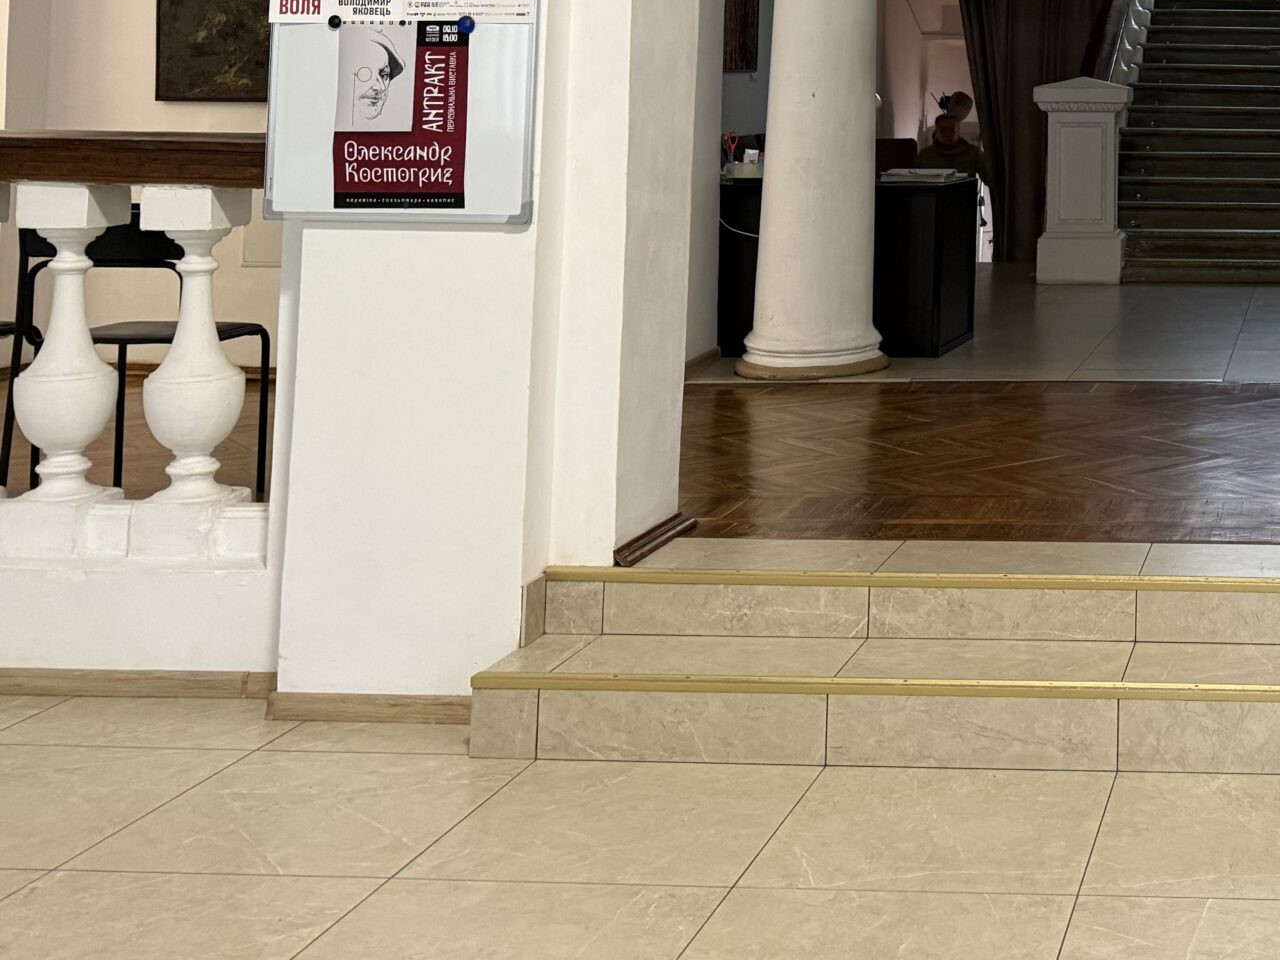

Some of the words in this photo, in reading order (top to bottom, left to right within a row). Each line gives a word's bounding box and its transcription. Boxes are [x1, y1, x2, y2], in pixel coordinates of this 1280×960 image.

[352, 7, 391, 16] ЯКОВЕЦЬ
[448, 51, 456, 86] ВИСТАВКА
[422, 51, 446, 132] АНТРАКТ
[447, 86, 456, 132] ПЕРСОНАЛЬНА
[344, 140, 452, 166] Олександр
[345, 162, 453, 188] Костогриз
